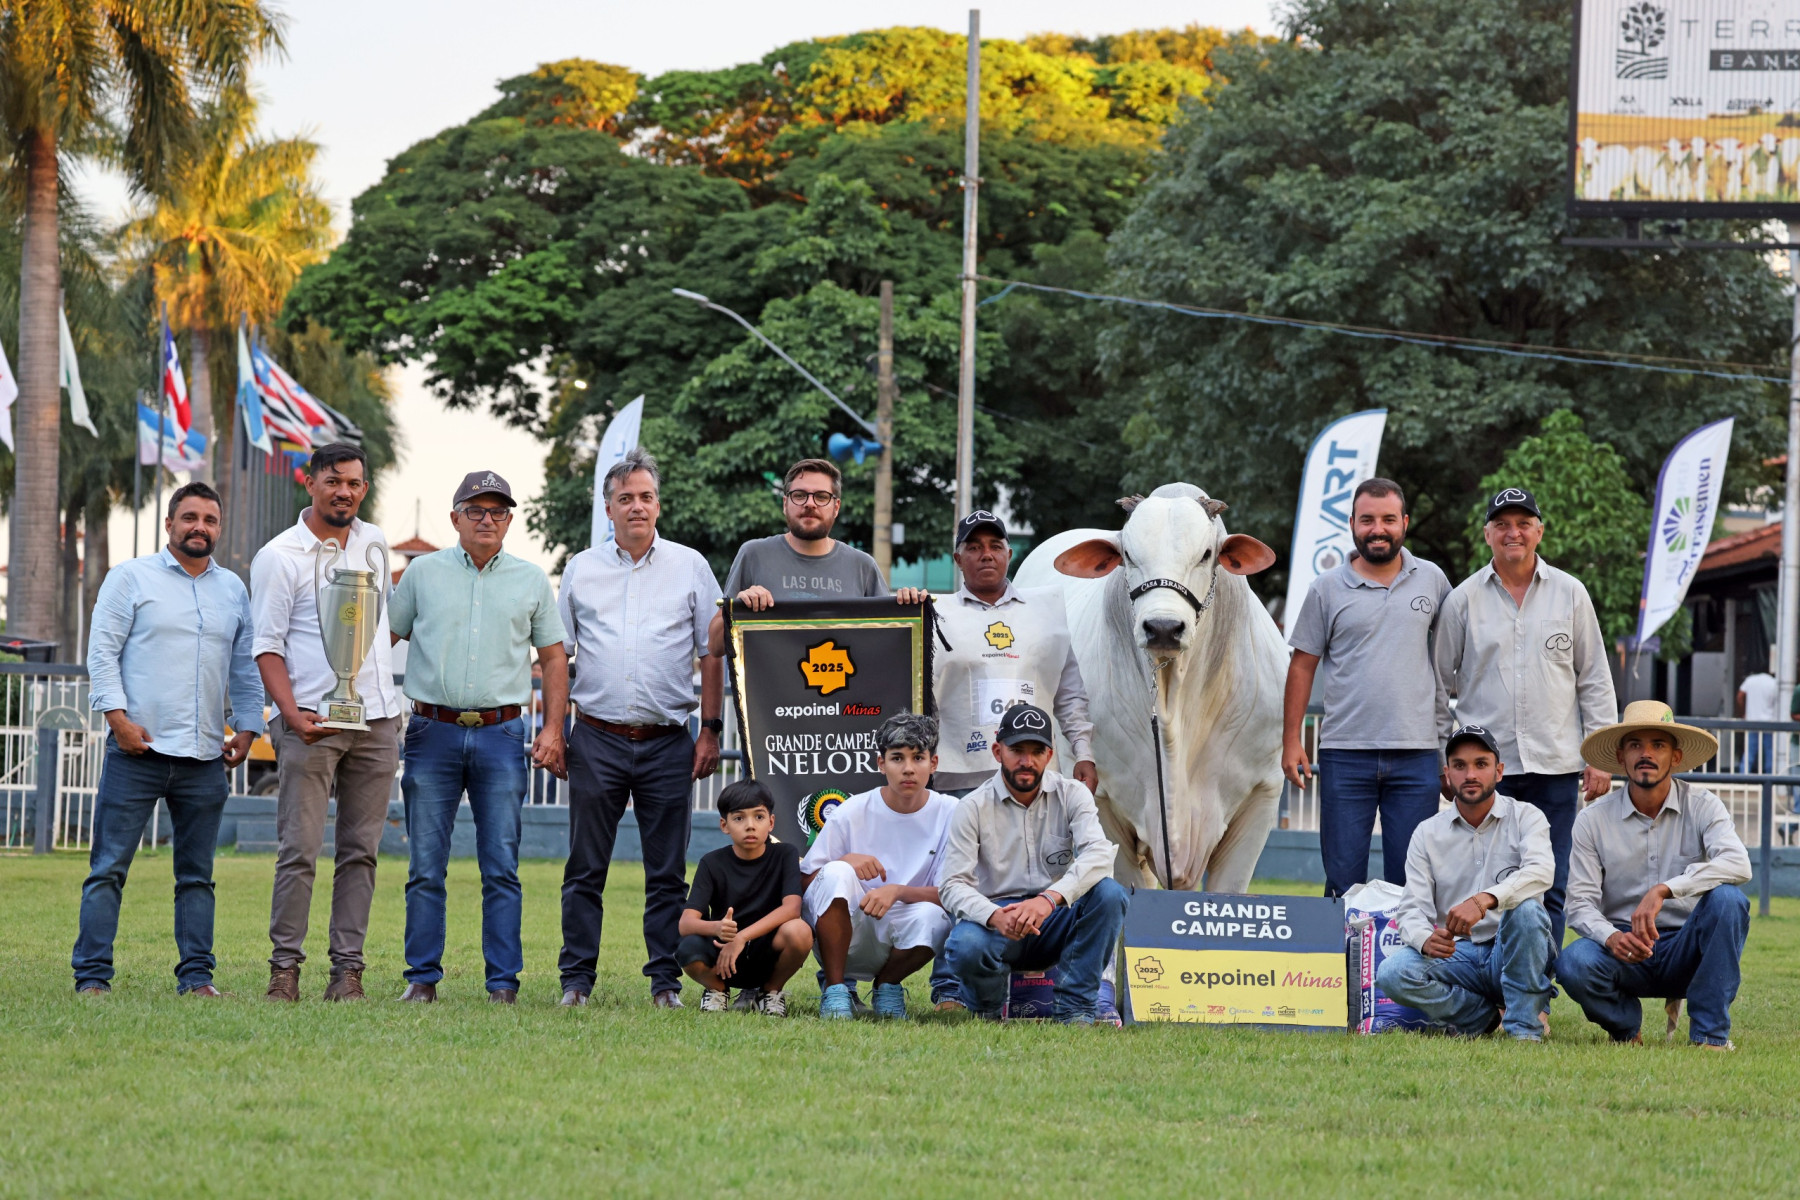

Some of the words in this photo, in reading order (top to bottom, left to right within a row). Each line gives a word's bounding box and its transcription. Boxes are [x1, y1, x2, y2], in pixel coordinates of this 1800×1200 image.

[481, 479, 502, 489] RAC
[782, 575, 807, 590] LAS
[810, 576, 843, 594] OLAS
[1140, 580, 1158, 592] CASA
[1160, 579, 1188, 596] BRANCA
[811, 662, 844, 674] 2025
[774, 702, 840, 720] expoinel
[842, 702, 882, 717] Minas
[765, 733, 822, 752] GRANDE
[825, 729, 879, 750] CAMPEÃ
[966, 740, 988, 750] ABCZ
[767, 750, 881, 775] NELOR
[1184, 901, 1287, 921] GRANDE
[1171, 920, 1293, 940] CAMPEÃO
[1382, 933, 1405, 946] RE
[1361, 924, 1371, 987] MATSUDA
[1013, 978, 1056, 988] MATSUDA
[1179, 968, 1276, 989] expoinel
[1281, 970, 1343, 989] Minas
